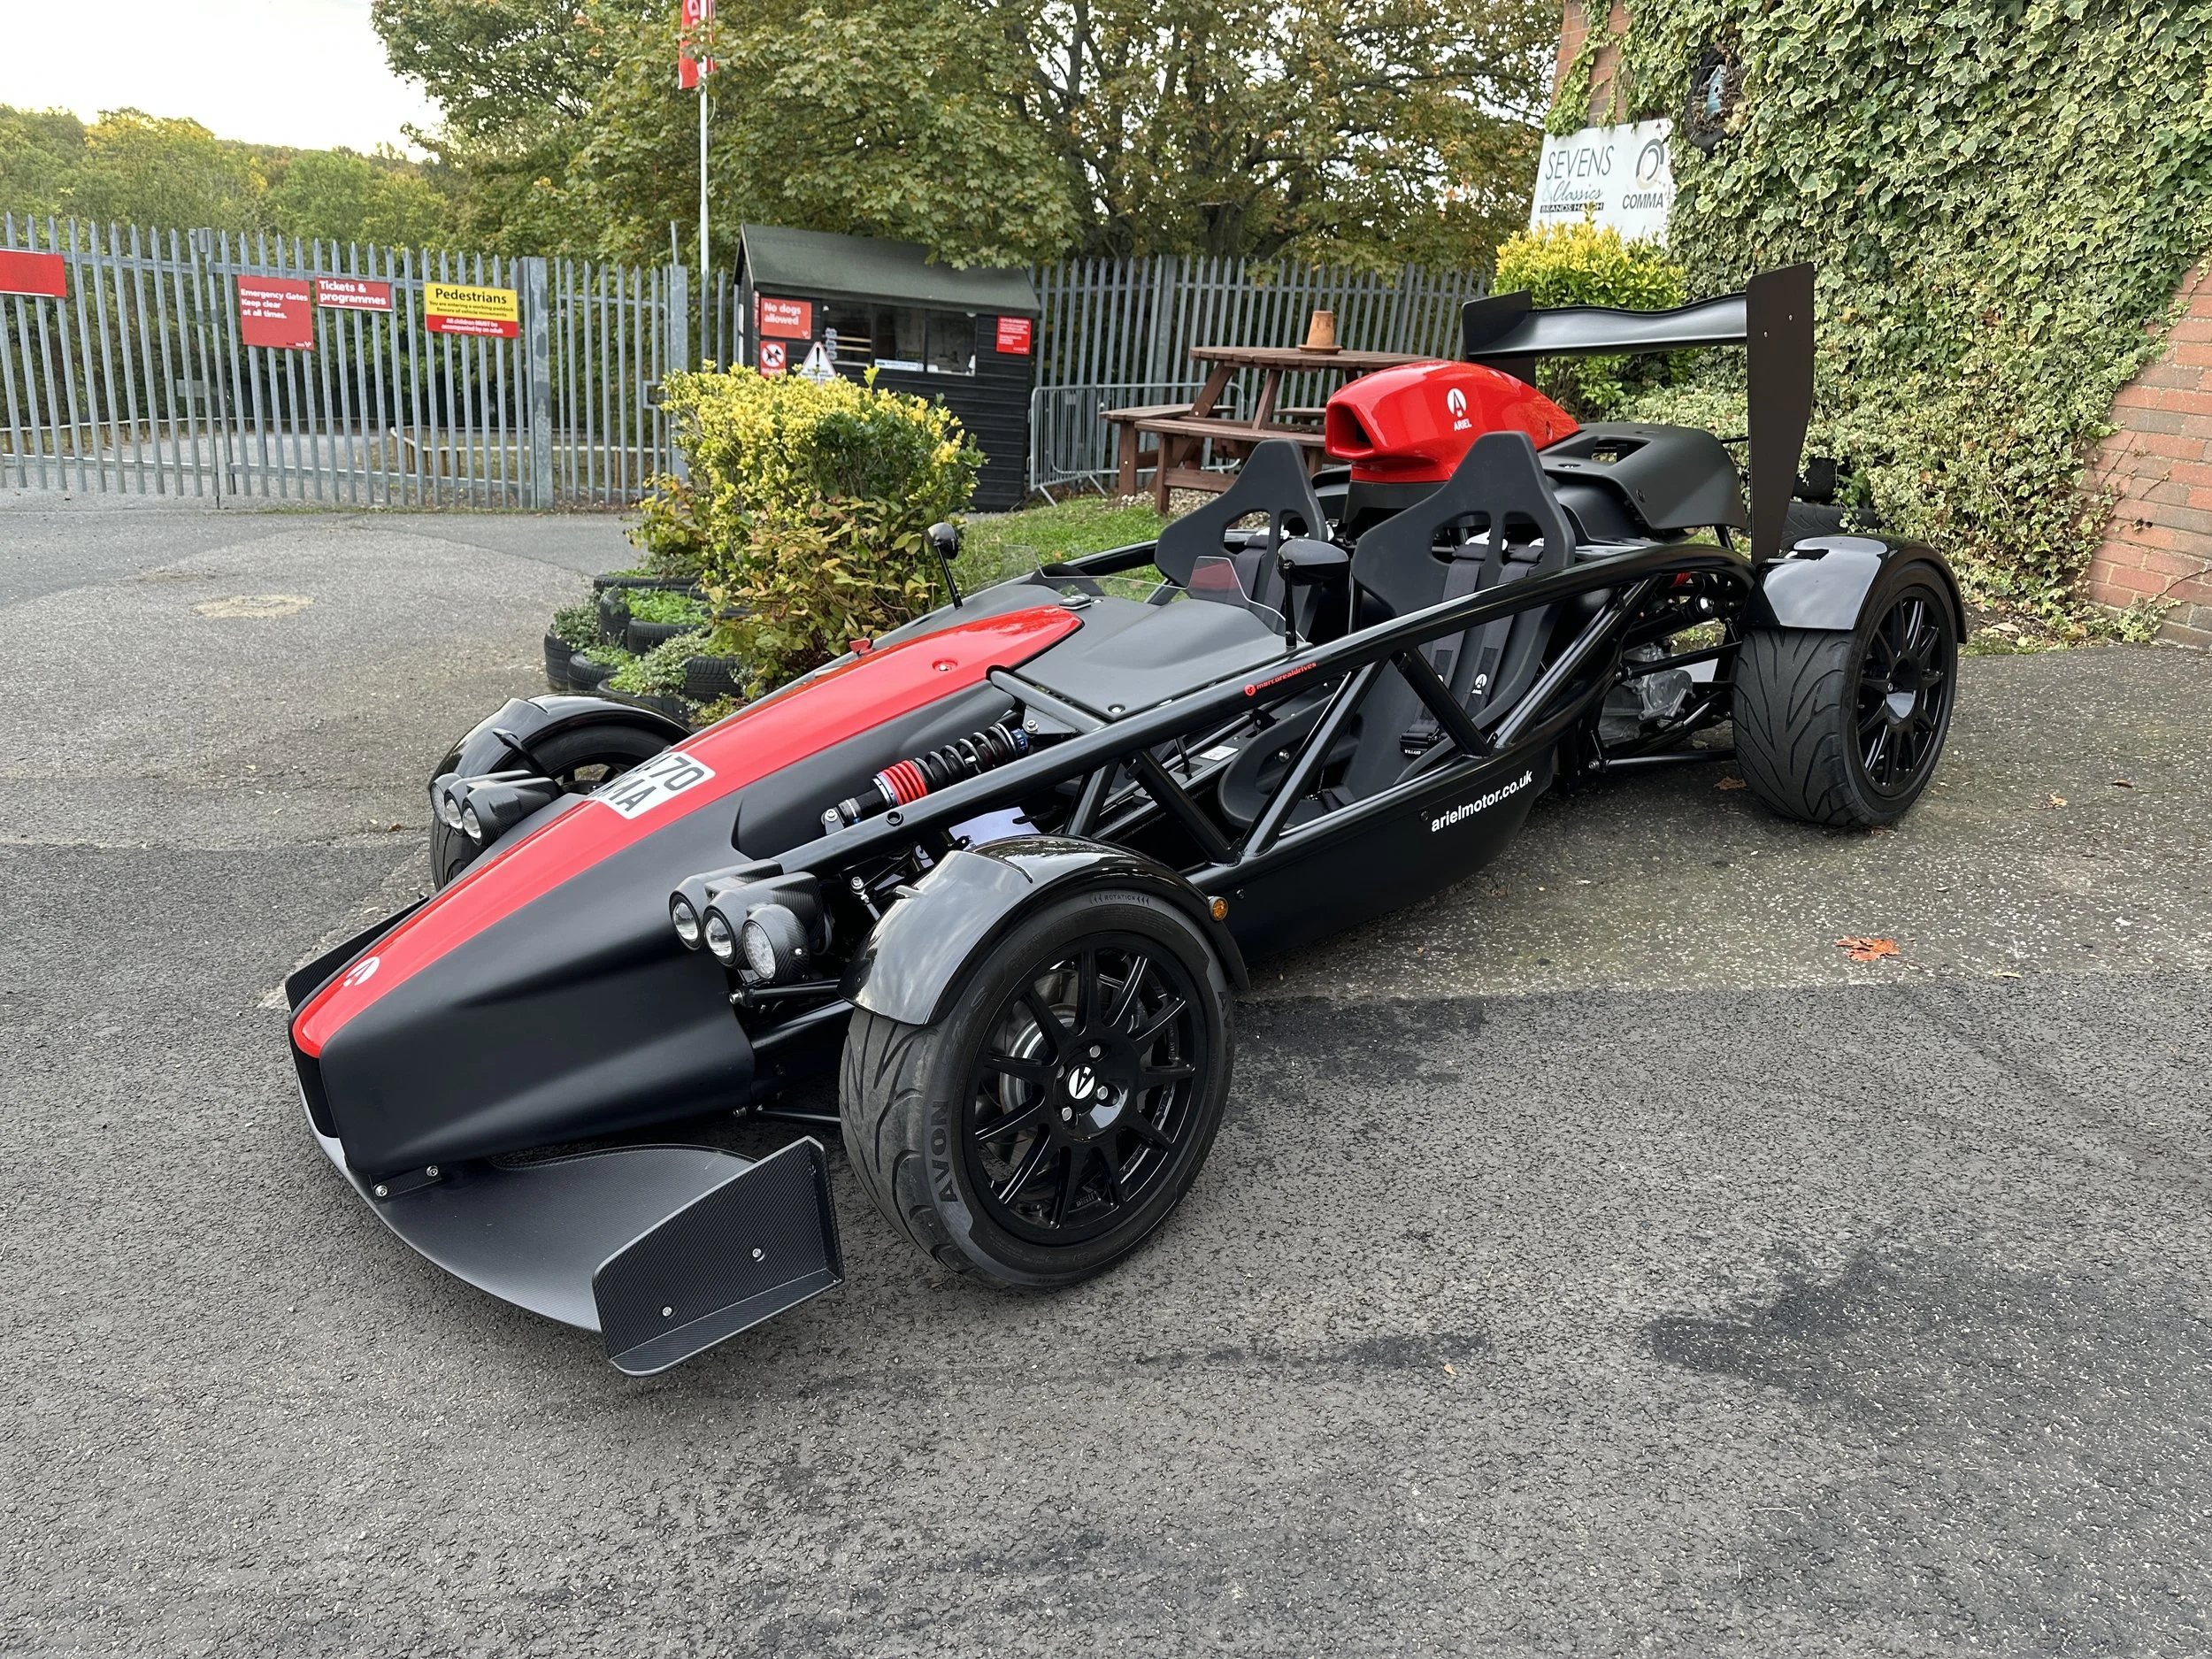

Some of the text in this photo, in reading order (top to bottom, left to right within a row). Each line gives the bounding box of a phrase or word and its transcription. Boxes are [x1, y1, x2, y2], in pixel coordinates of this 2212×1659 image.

[1545, 145, 1615, 180] SEVENS
[1553, 180, 1603, 202] Classics
[1542, 204, 1572, 212] BRANDS
[1622, 192, 1663, 210] COMMA
[319, 280, 367, 293] Tickets &
[240, 288, 309, 302] Emergency Gates
[319, 293, 387, 305] programmes
[435, 288, 507, 304] Pedestrians
[241, 298, 281, 309] Keep clear
[764, 302, 802, 316] No dogs
[263, 310, 288, 319] times.
[764, 313, 799, 326] allowed
[1454, 418, 1472, 432] ARIEL
[637, 755, 705, 791] 70
[1431, 770, 1532, 832] arielmotor.co.uk
[931, 1101, 958, 1202] AVON
